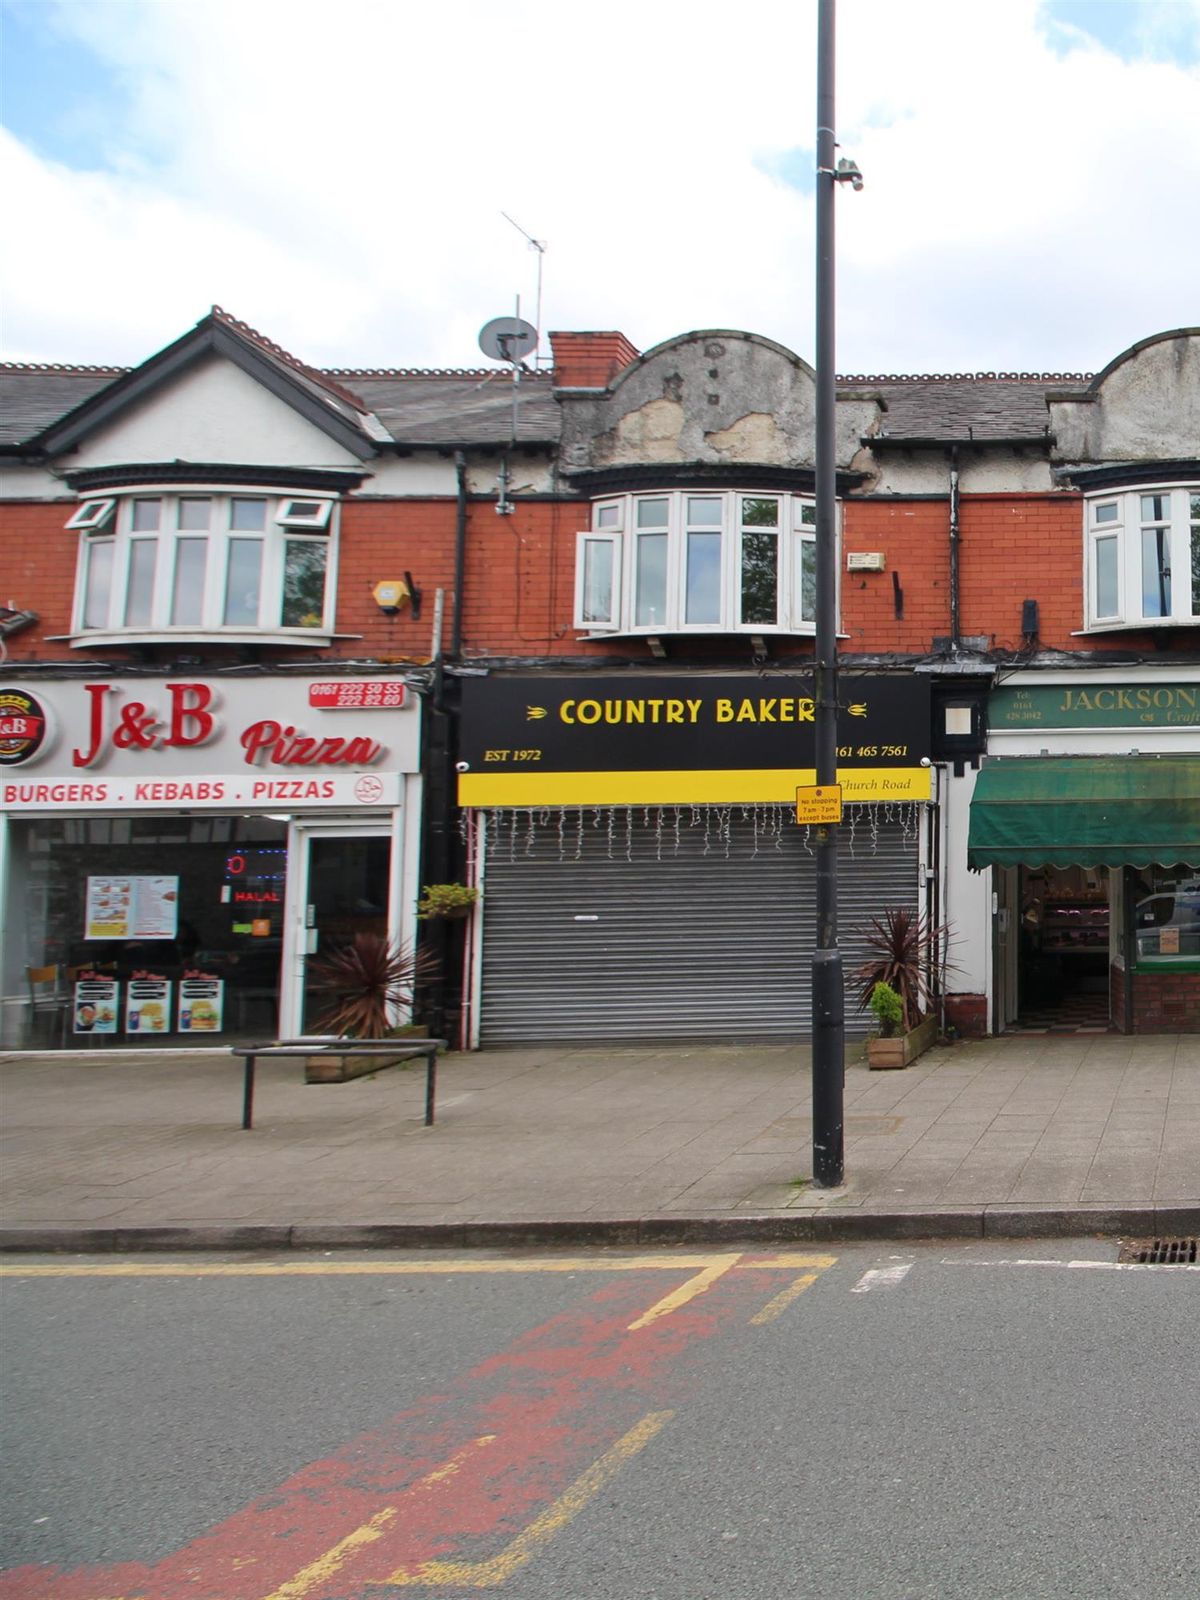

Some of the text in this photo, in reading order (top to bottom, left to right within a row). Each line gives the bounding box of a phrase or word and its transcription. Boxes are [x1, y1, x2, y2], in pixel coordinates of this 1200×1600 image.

[310, 683, 401, 695] 0161 222 50 55
[337, 695, 362, 705] 222
[383, 695, 400, 704] 60
[1060, 688, 1196, 711] JACKSON
[560, 698, 816, 724] COUNTRY BAKER
[1166, 711, 1200, 724] Craft
[73, 683, 213, 767] J&B
[240, 720, 382, 764] Pizza
[484, 750, 541, 761] EST 1972
[836, 746, 908, 757] 161 465 7561
[838, 779, 911, 790] Church Road
[5, 781, 335, 802] BURGERS KEBABS PIZZAS
[234, 892, 280, 902] HALAL
